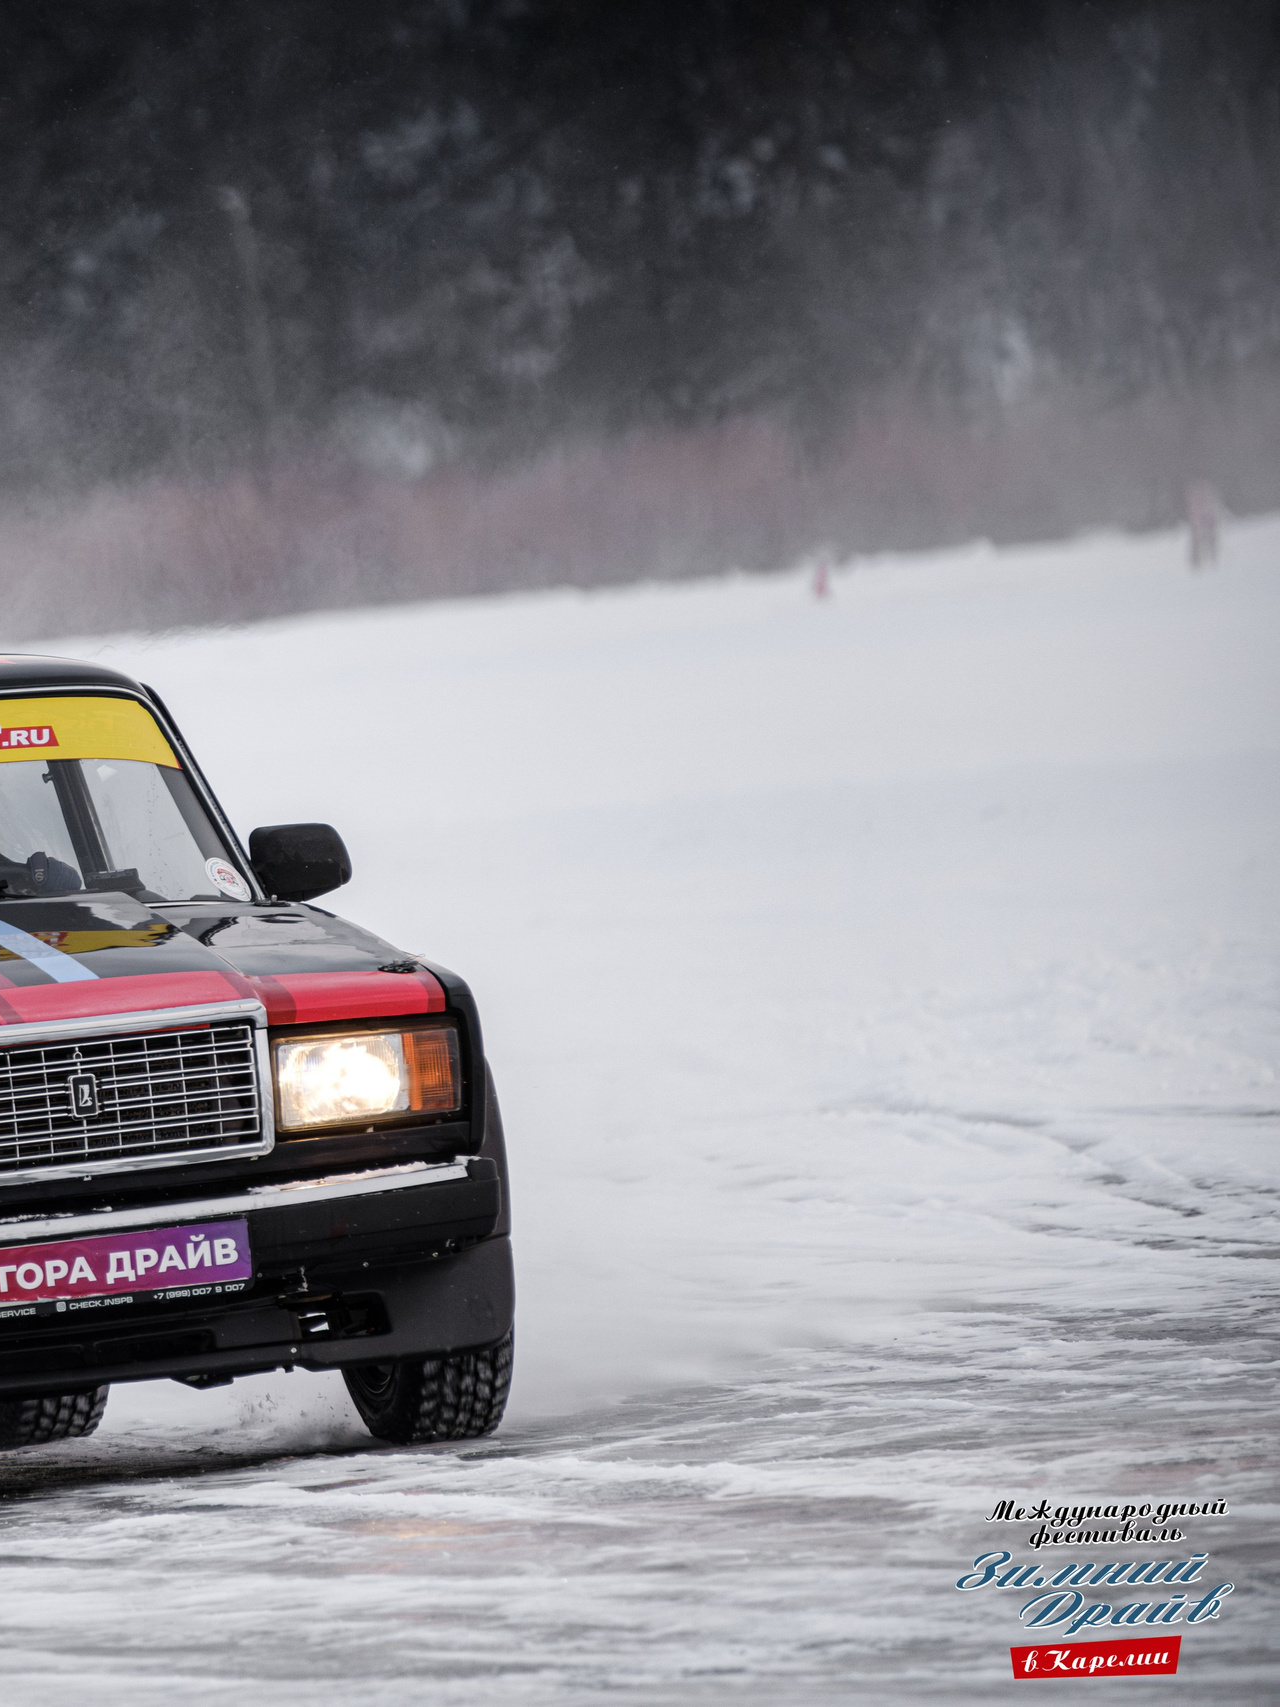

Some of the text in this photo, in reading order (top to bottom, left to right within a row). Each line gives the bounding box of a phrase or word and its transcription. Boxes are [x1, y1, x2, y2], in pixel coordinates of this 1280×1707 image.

[2, 728, 50, 747] .RU
[106, 1233, 239, 1285] ДРАЙВ
[192, 1287, 212, 1296] 007
[225, 1283, 245, 1292] 007
